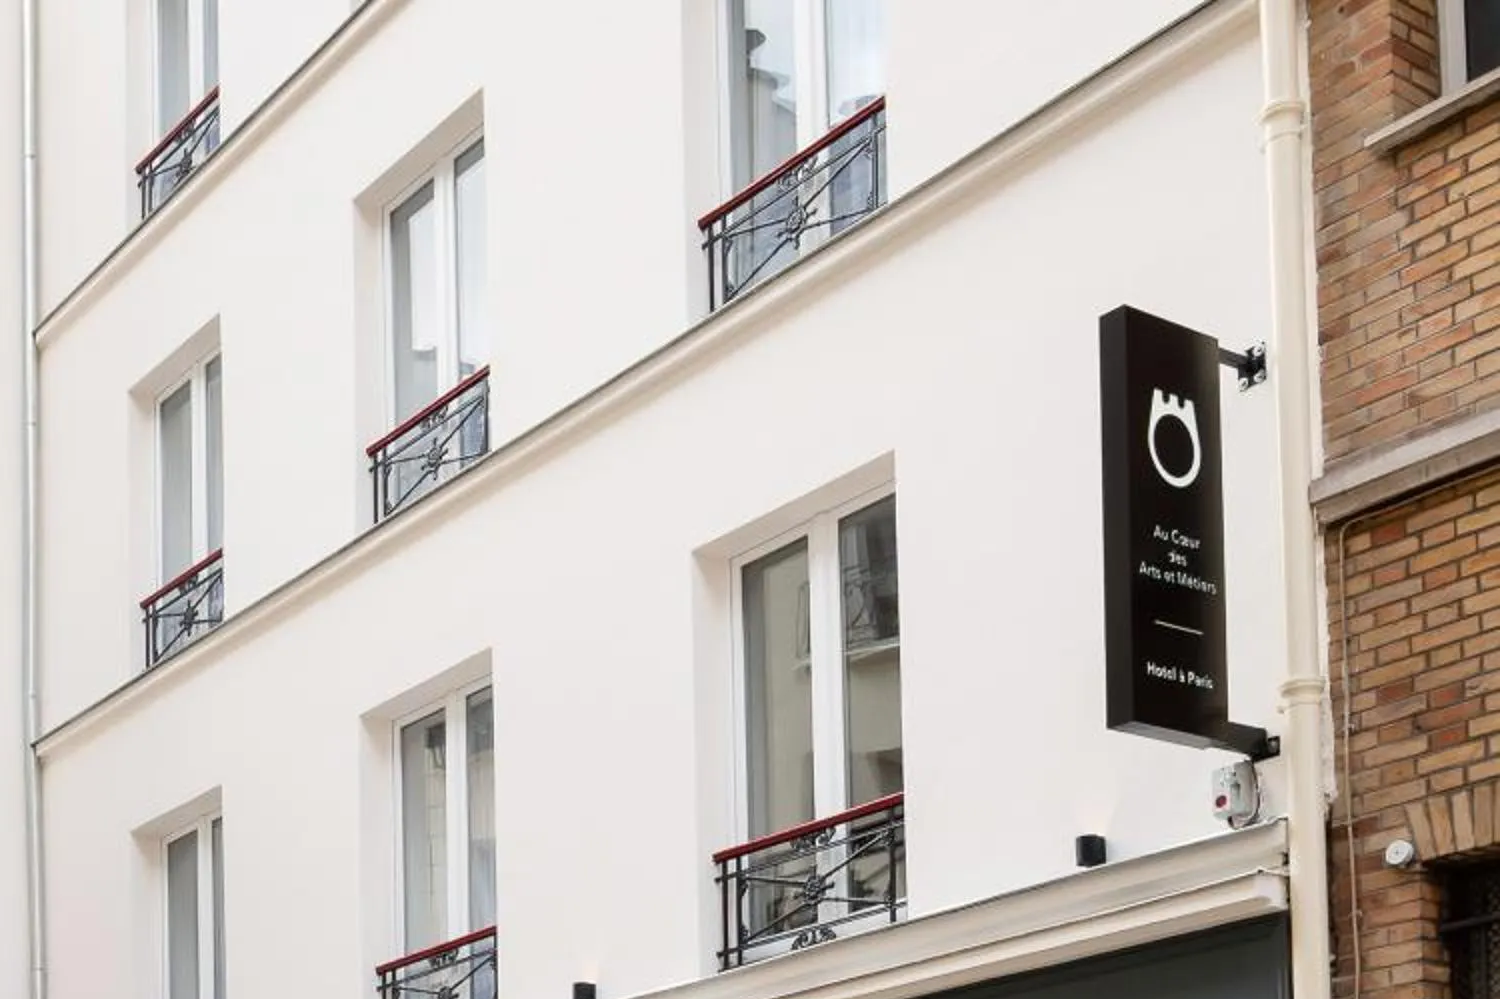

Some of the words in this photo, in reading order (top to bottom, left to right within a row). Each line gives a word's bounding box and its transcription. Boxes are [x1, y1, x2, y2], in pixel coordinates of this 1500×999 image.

[1153, 524, 1169, 541] Au
[1168, 550, 1187, 567] des
[1139, 561, 1162, 580] Arts
[1164, 571, 1175, 584] et
[1187, 671, 1214, 689] Paris
